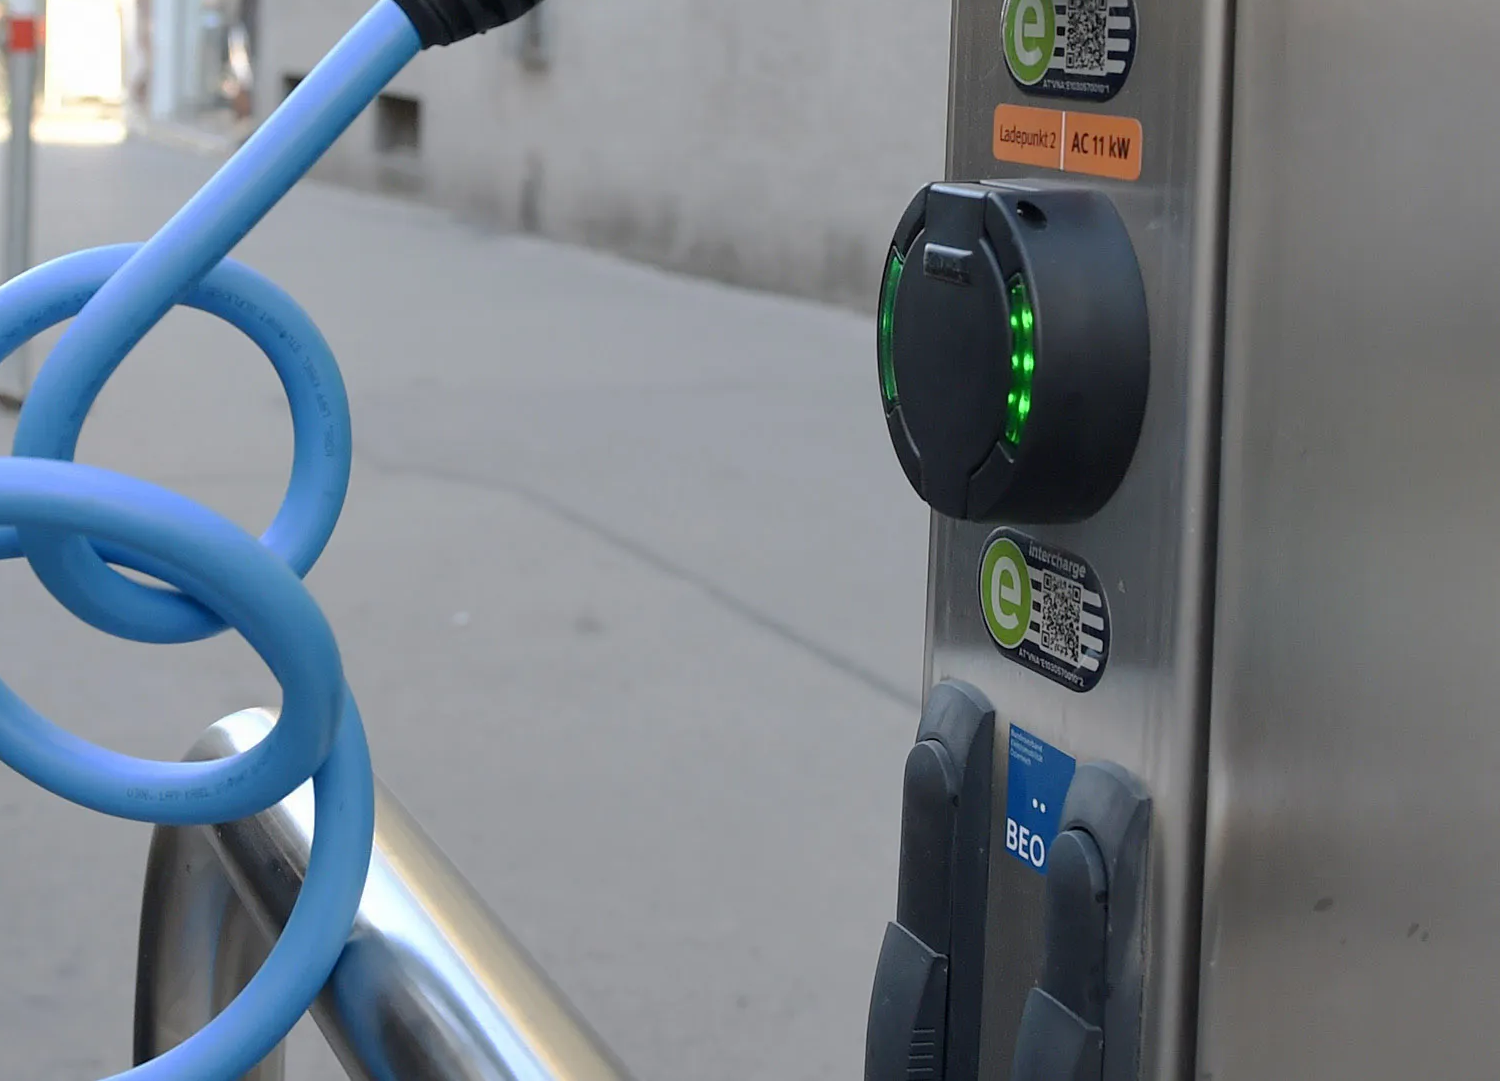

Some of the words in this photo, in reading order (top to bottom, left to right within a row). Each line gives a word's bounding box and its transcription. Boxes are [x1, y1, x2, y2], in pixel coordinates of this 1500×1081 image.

[1000, 124, 1048, 149] Ladepunkt
[1050, 131, 1056, 149] 2
[1071, 131, 1090, 154] AC
[1092, 135, 1105, 156] 11
[1108, 135, 1131, 160] kW
[1028, 541, 1087, 579] intercharge
